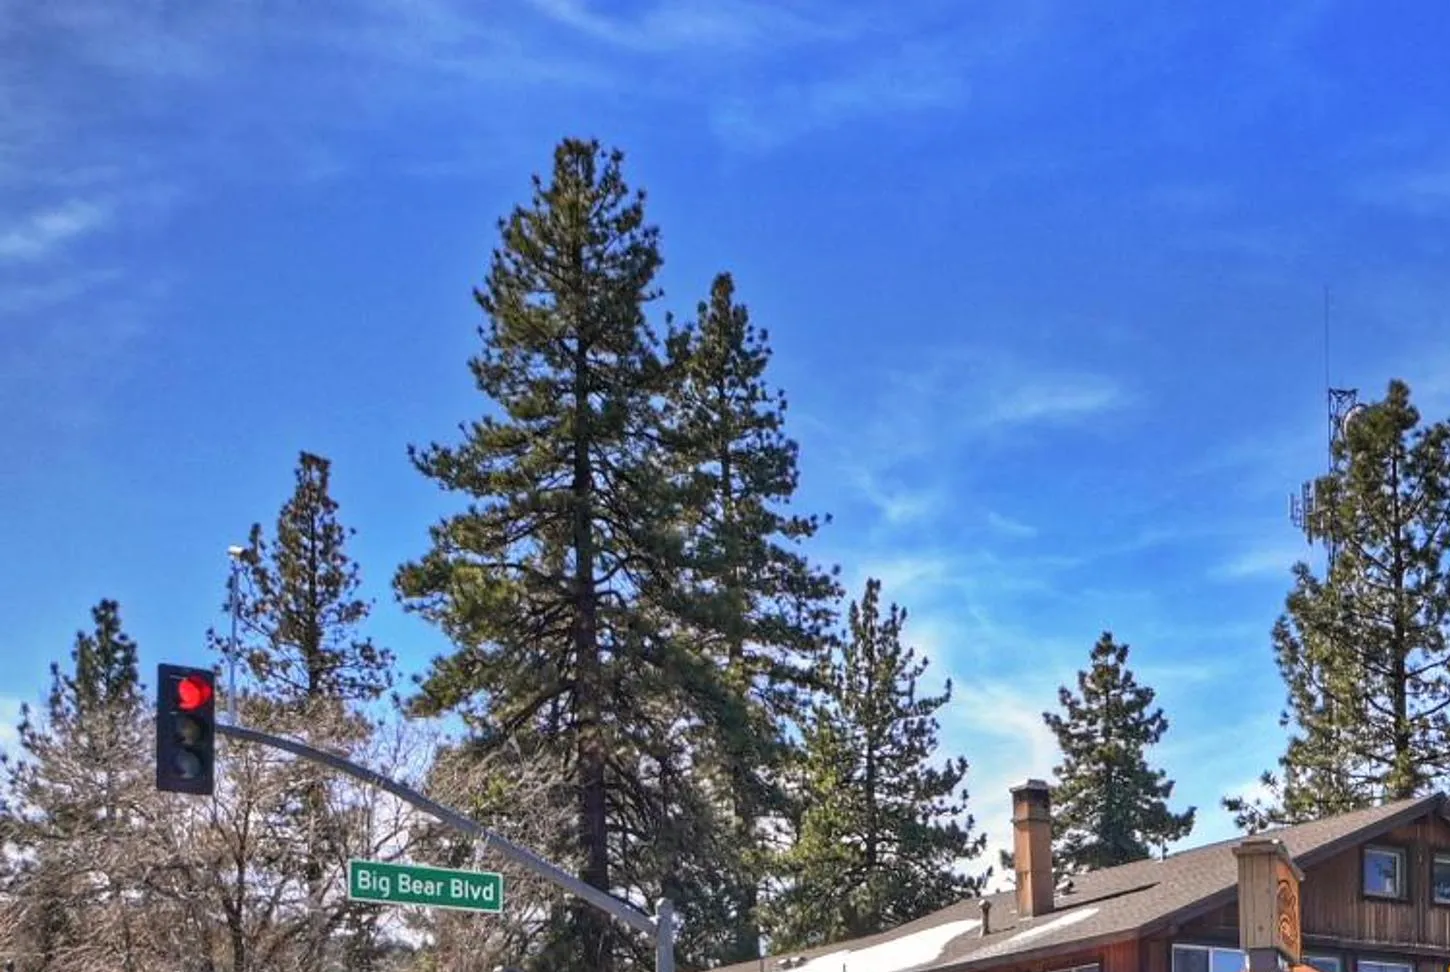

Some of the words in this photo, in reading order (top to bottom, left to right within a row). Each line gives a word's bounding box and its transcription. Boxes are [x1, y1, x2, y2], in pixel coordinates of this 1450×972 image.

[357, 870, 391, 898] Big
[398, 873, 443, 896] Bear
[451, 878, 494, 901] Blvd
